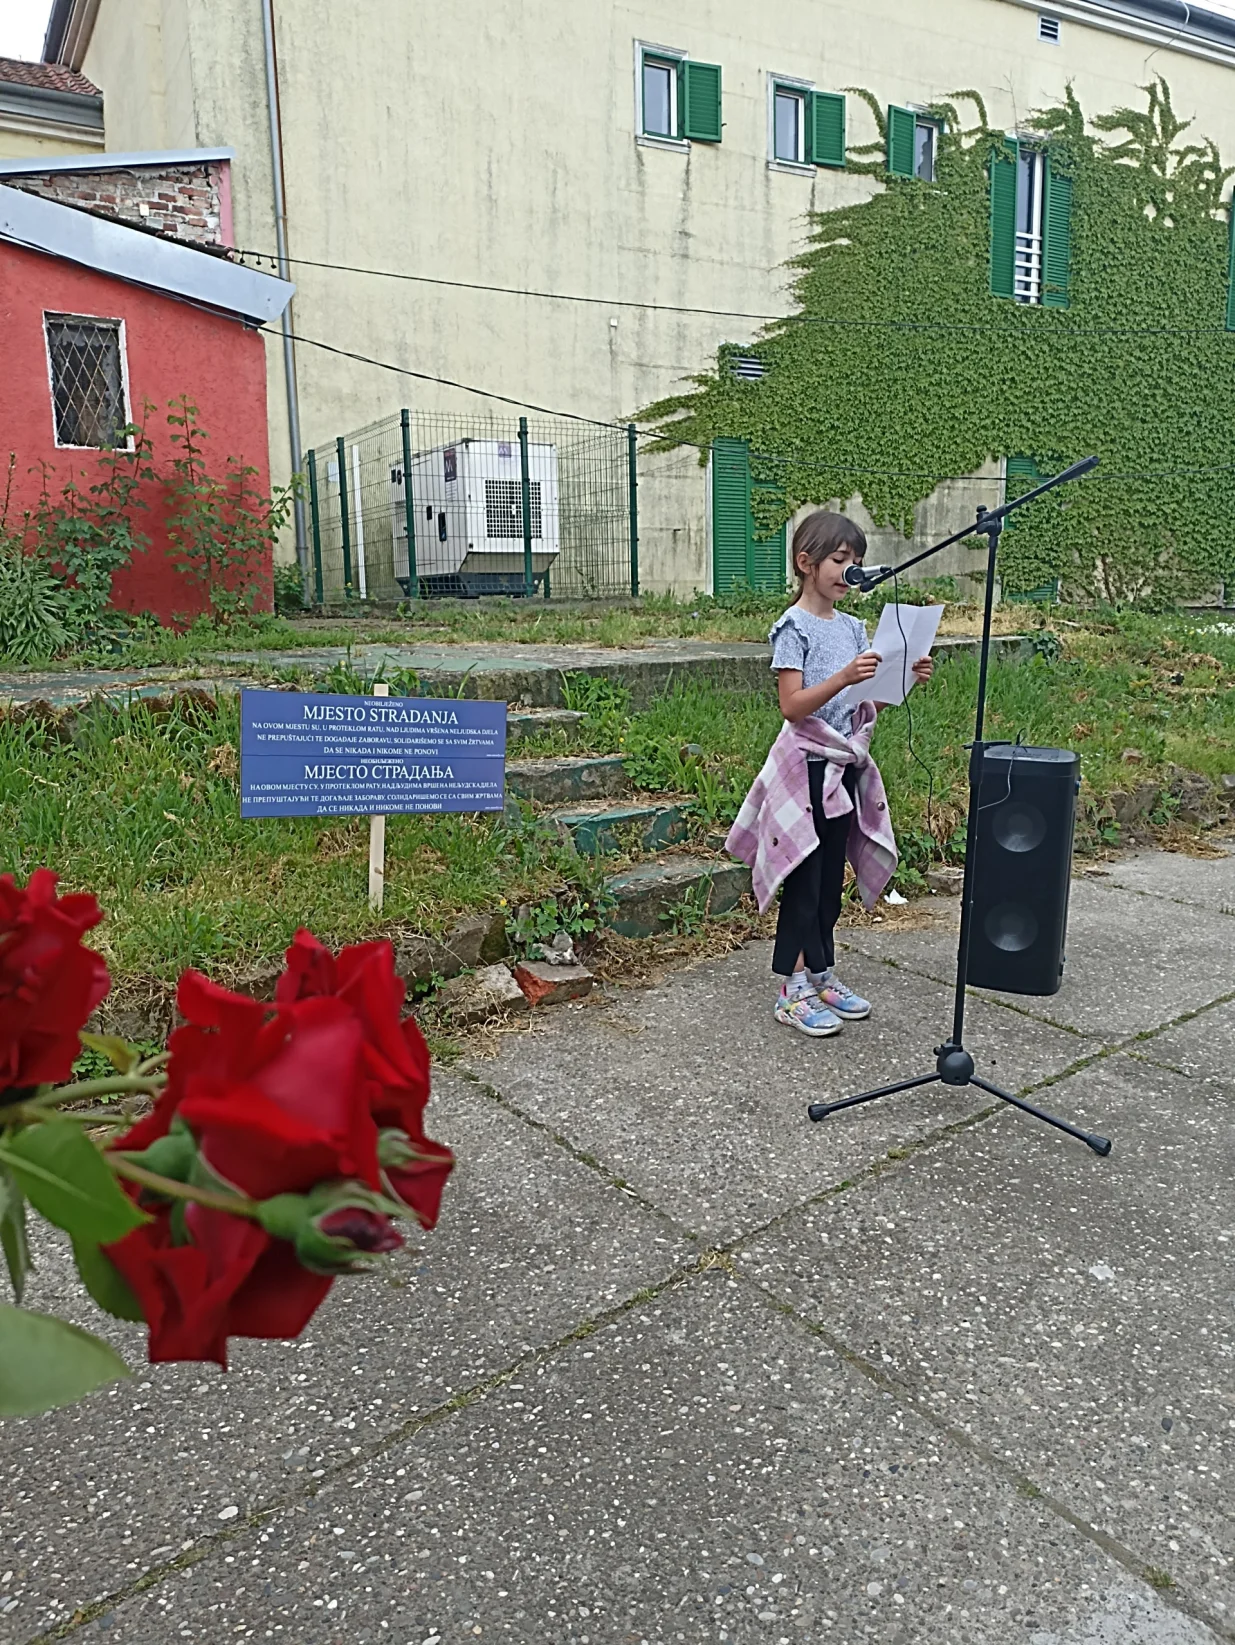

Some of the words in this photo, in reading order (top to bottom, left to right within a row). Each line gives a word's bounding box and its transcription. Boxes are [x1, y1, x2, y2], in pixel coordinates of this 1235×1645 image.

[303, 705, 366, 721] MJESTO
[370, 707, 459, 724] STRADANJA
[263, 722, 284, 730] OVOM
[285, 723, 310, 731] MJESTU
[328, 724, 367, 732] PROTEKLOM
[400, 726, 425, 734] LJUDIMA
[426, 726, 449, 735] VRŠENA
[481, 728, 499, 736] DJELA
[268, 733, 314, 742] PREPUŠTAJUĆI
[393, 737, 437, 745] SOLIDARIŠEMO
[468, 738, 494, 746] ŽRTVAMA
[323, 746, 334, 754] DA
[335, 746, 343, 754] SE
[344, 747, 372, 755] NIKADA
[414, 748, 439, 756] PONOVI
[304, 765, 368, 779] МЈЕСТО
[371, 765, 454, 781] СТРАДАЊА
[317, 805, 327, 813] ДА
[339, 804, 367, 813] НИКАДА
[375, 803, 404, 811] НИКОМЕ
